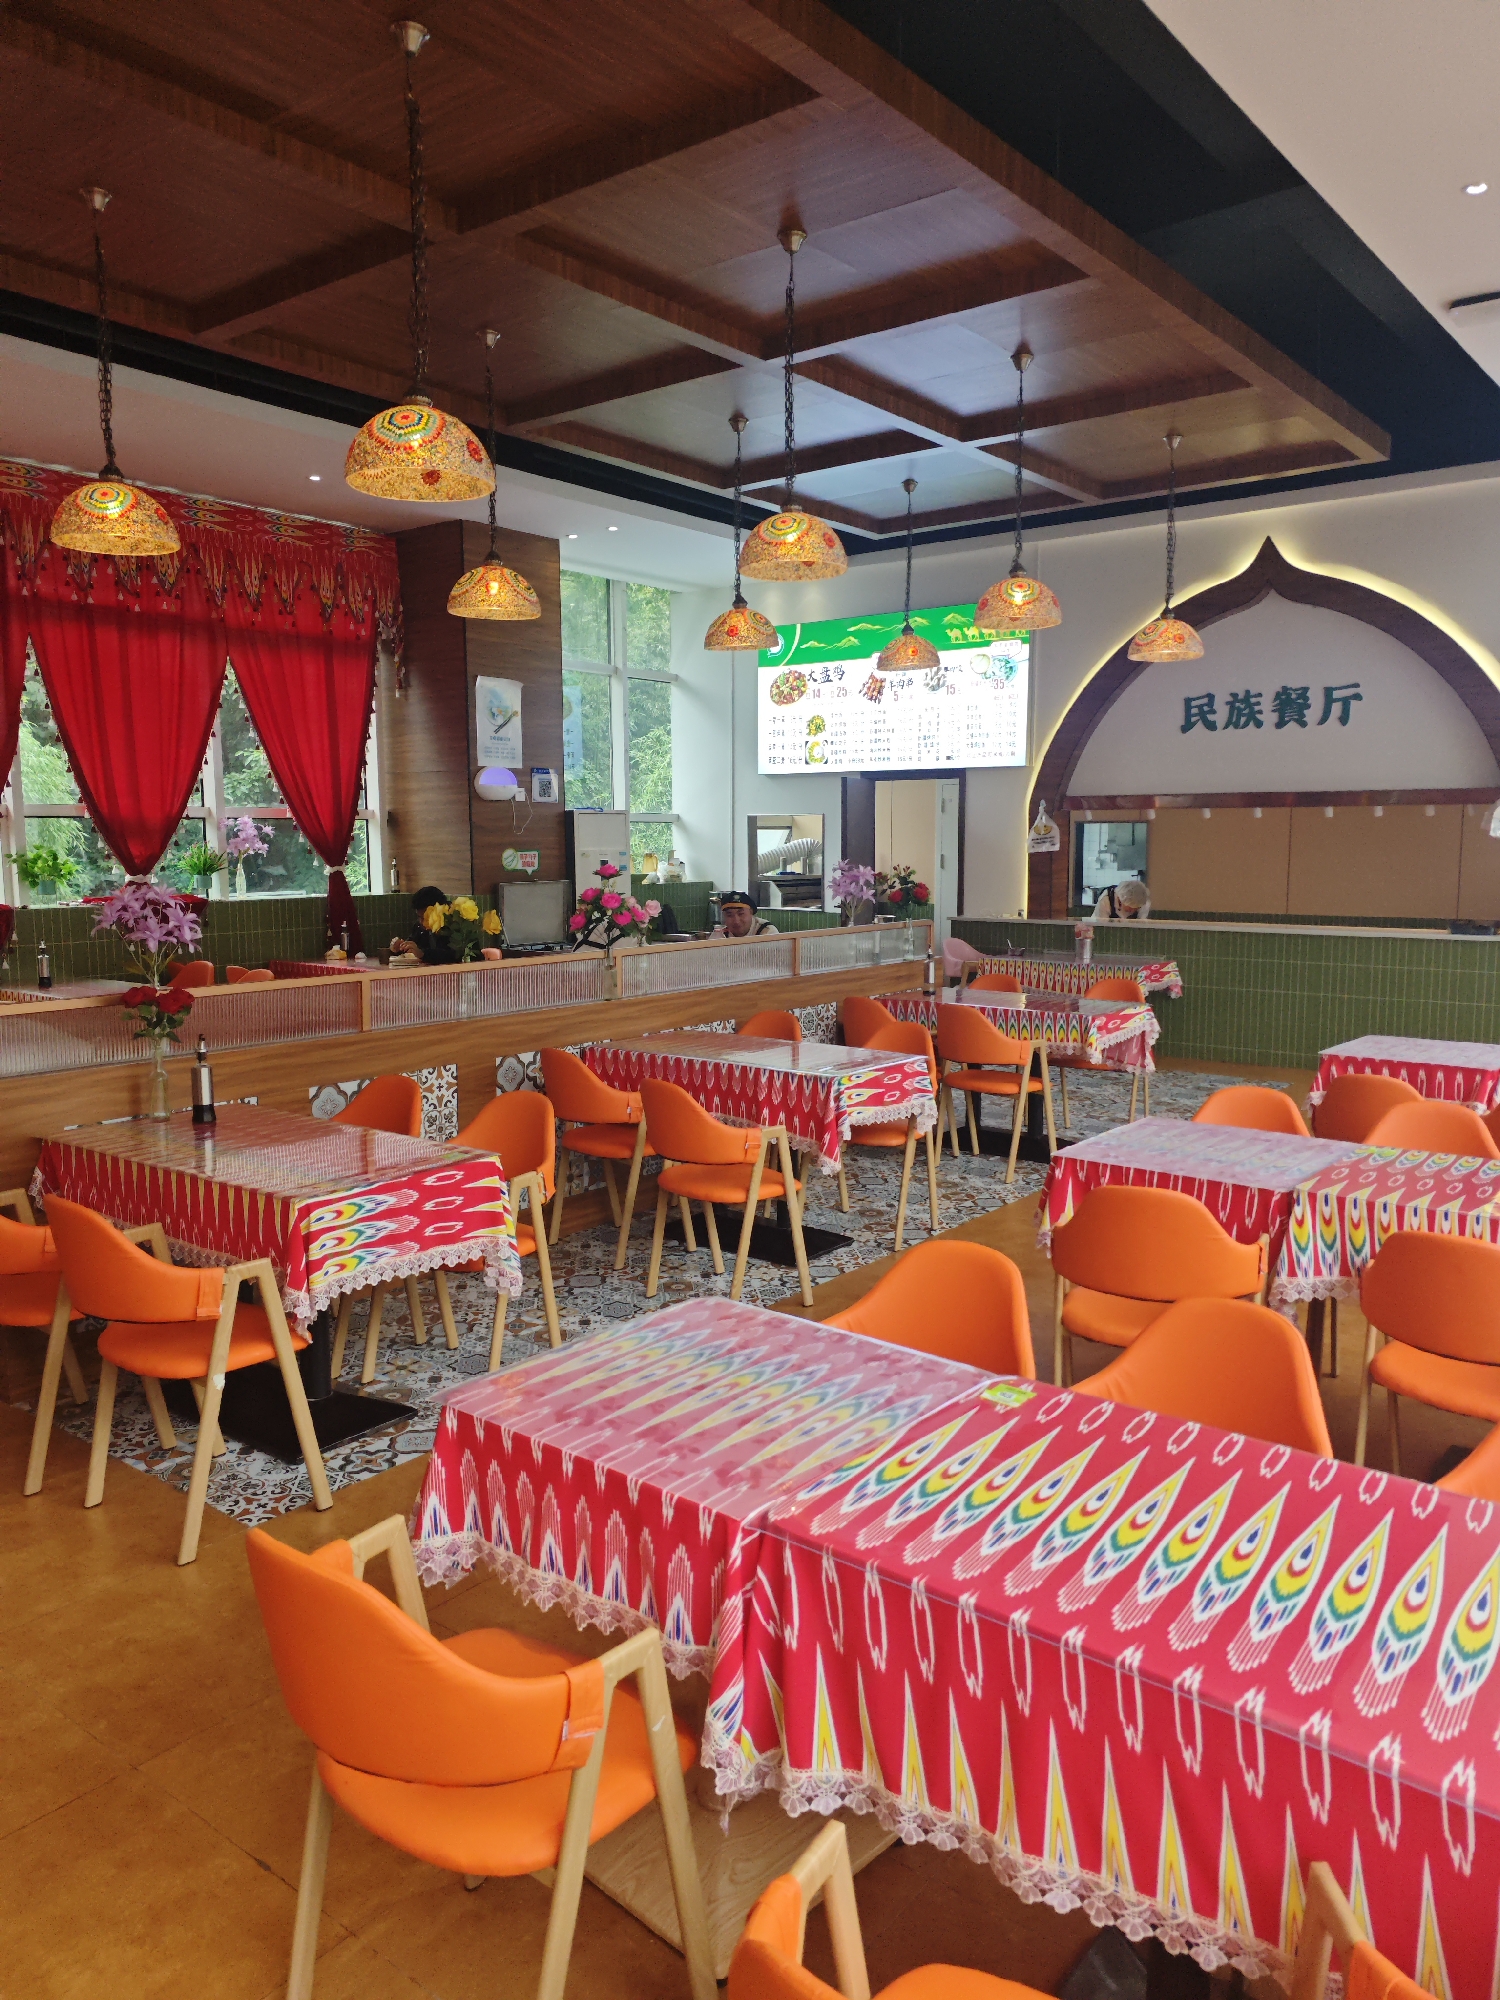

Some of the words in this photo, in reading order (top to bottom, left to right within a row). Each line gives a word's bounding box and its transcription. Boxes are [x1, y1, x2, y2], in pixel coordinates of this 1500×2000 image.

[807, 664, 846, 685] 大盘鸡
[1180, 683, 1364, 734] 民族餐厅
